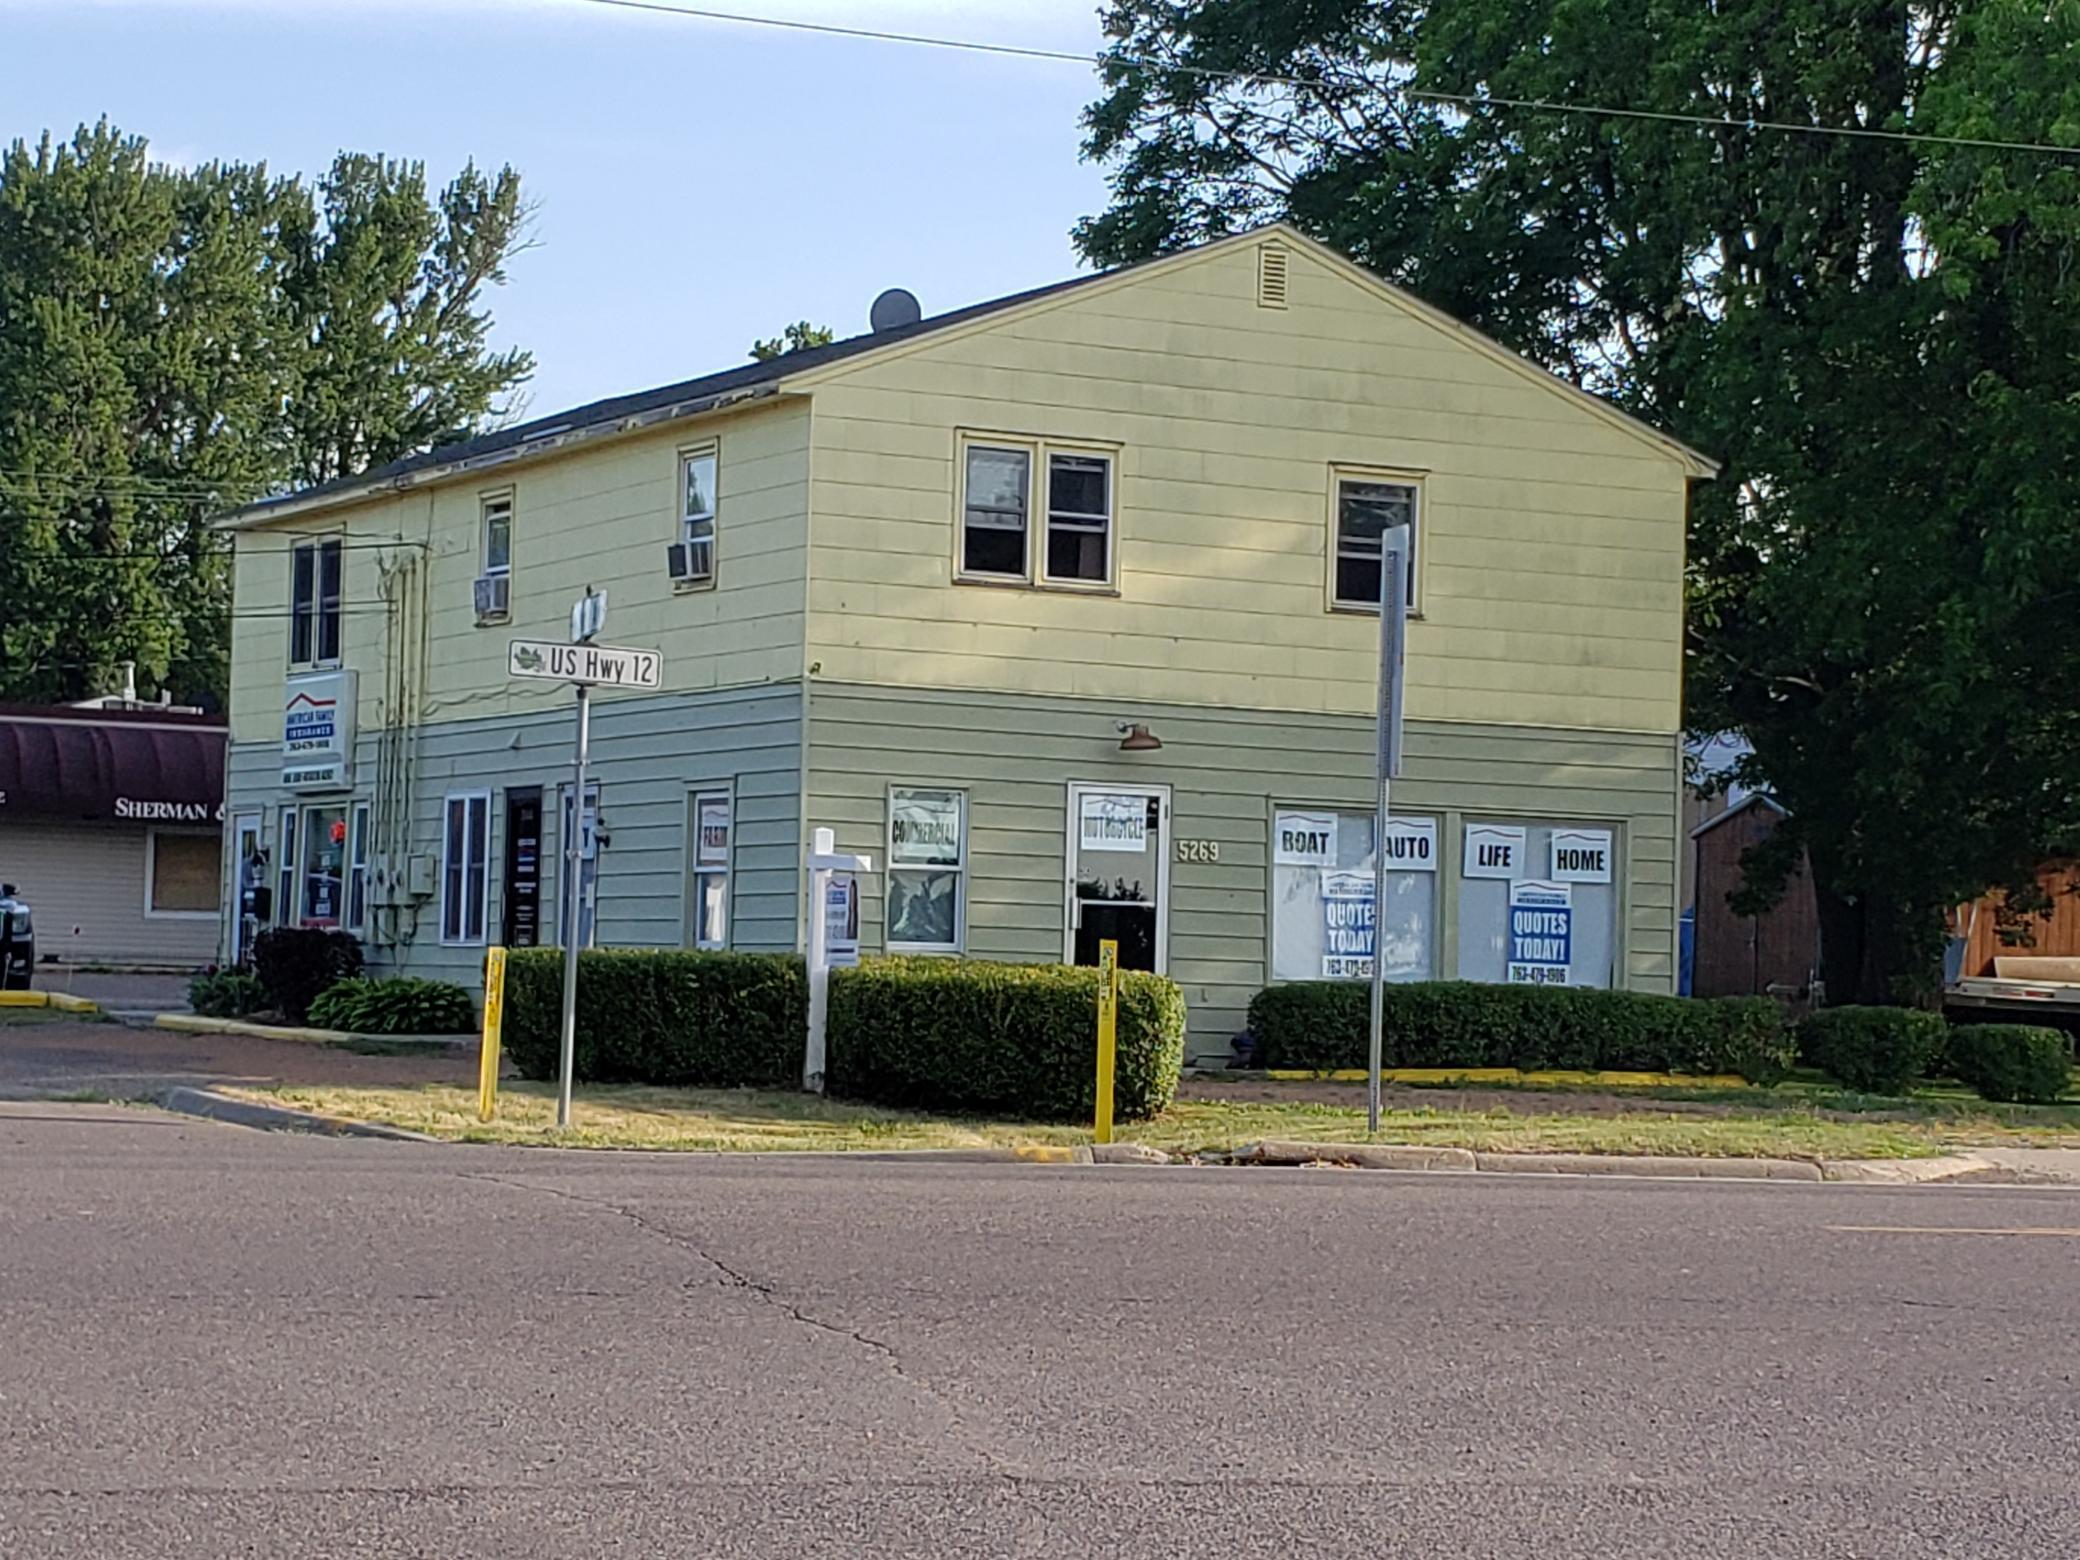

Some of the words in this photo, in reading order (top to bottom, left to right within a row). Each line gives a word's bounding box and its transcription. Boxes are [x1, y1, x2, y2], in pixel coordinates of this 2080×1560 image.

[551, 647, 577, 675] US
[586, 651, 625, 684] Hwy
[633, 655, 652, 683] 12
[115, 797, 208, 820] SHERMAN
[1178, 840, 1219, 862] 5269
[1282, 830, 1330, 854] BOAT
[1478, 844, 1512, 868] LIFE
[1556, 850, 1605, 871] HOME
[1513, 911, 1568, 936] QUOTES
[1514, 937, 1566, 961] TODAY!
